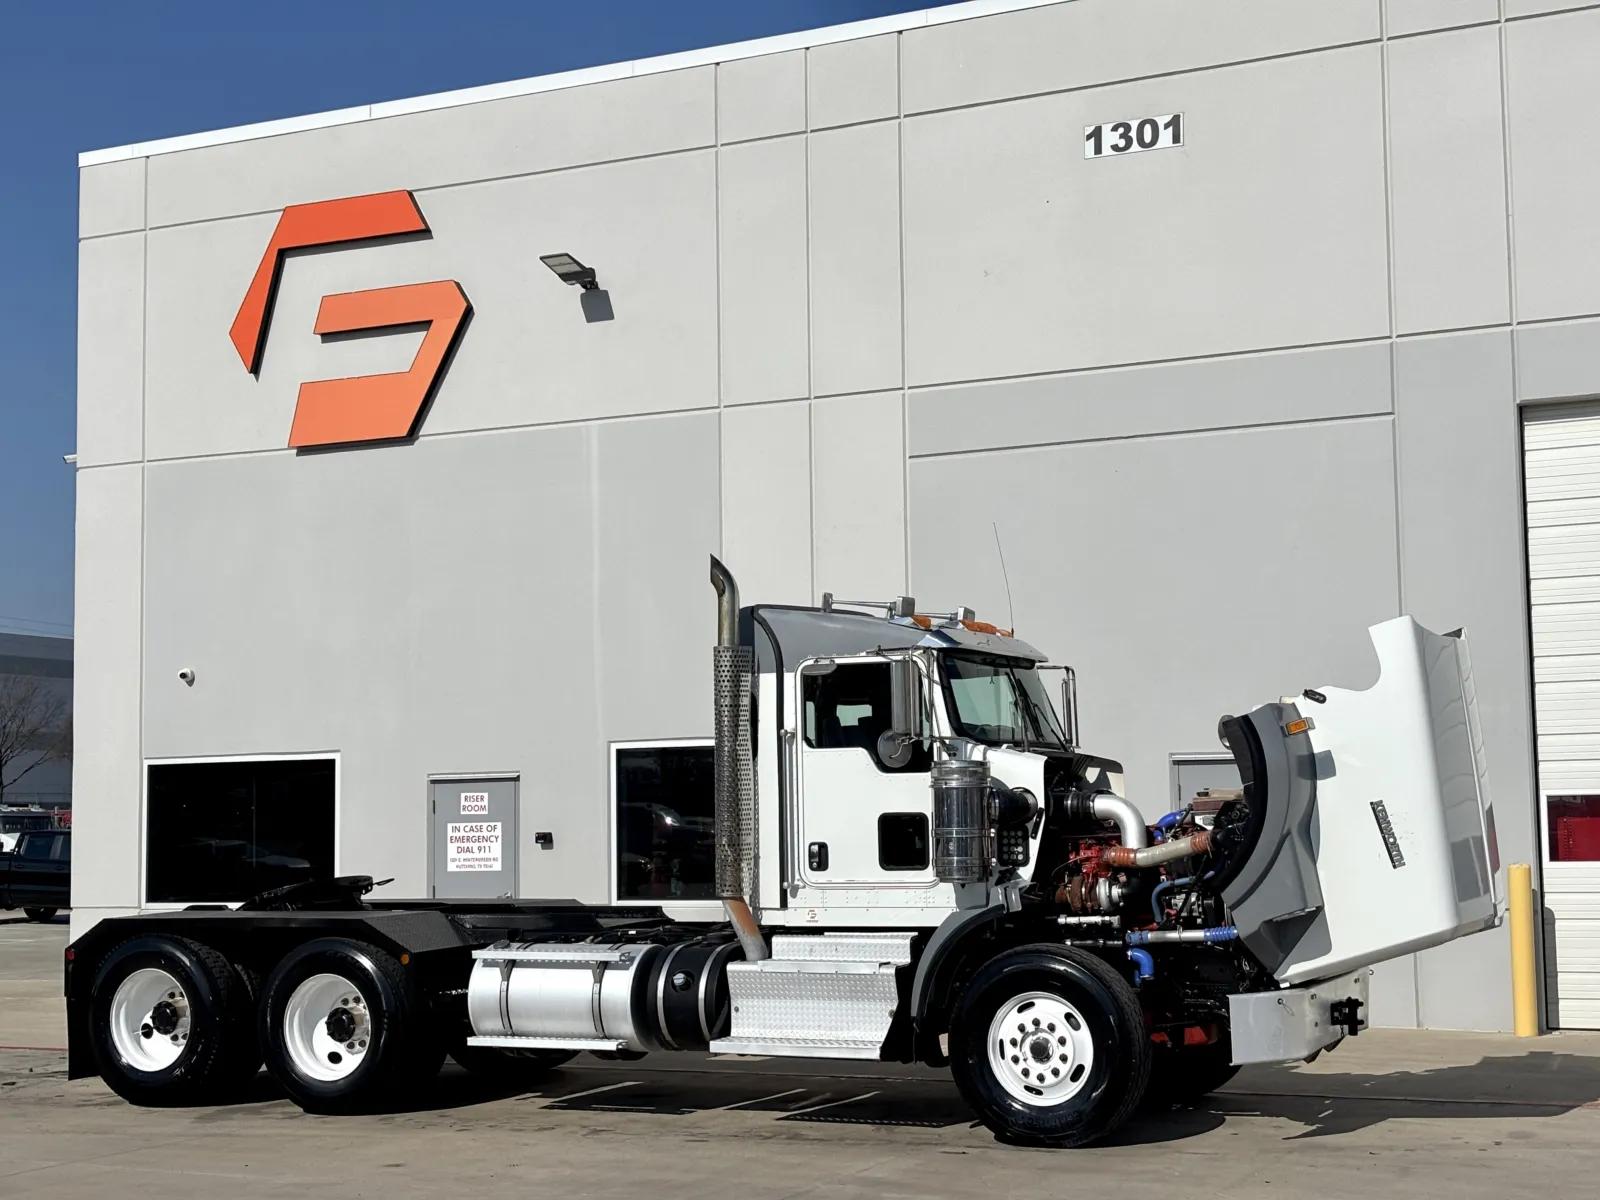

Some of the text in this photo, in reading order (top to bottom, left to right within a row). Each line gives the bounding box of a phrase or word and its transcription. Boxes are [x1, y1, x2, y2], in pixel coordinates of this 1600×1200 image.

[1085, 114, 1181, 156] 1301
[451, 824, 498, 833] IN CASE OF
[449, 835, 499, 843] EMERGENCY
[1371, 800, 1406, 869] KENWORTH
[456, 845, 491, 854] DIAL 911
